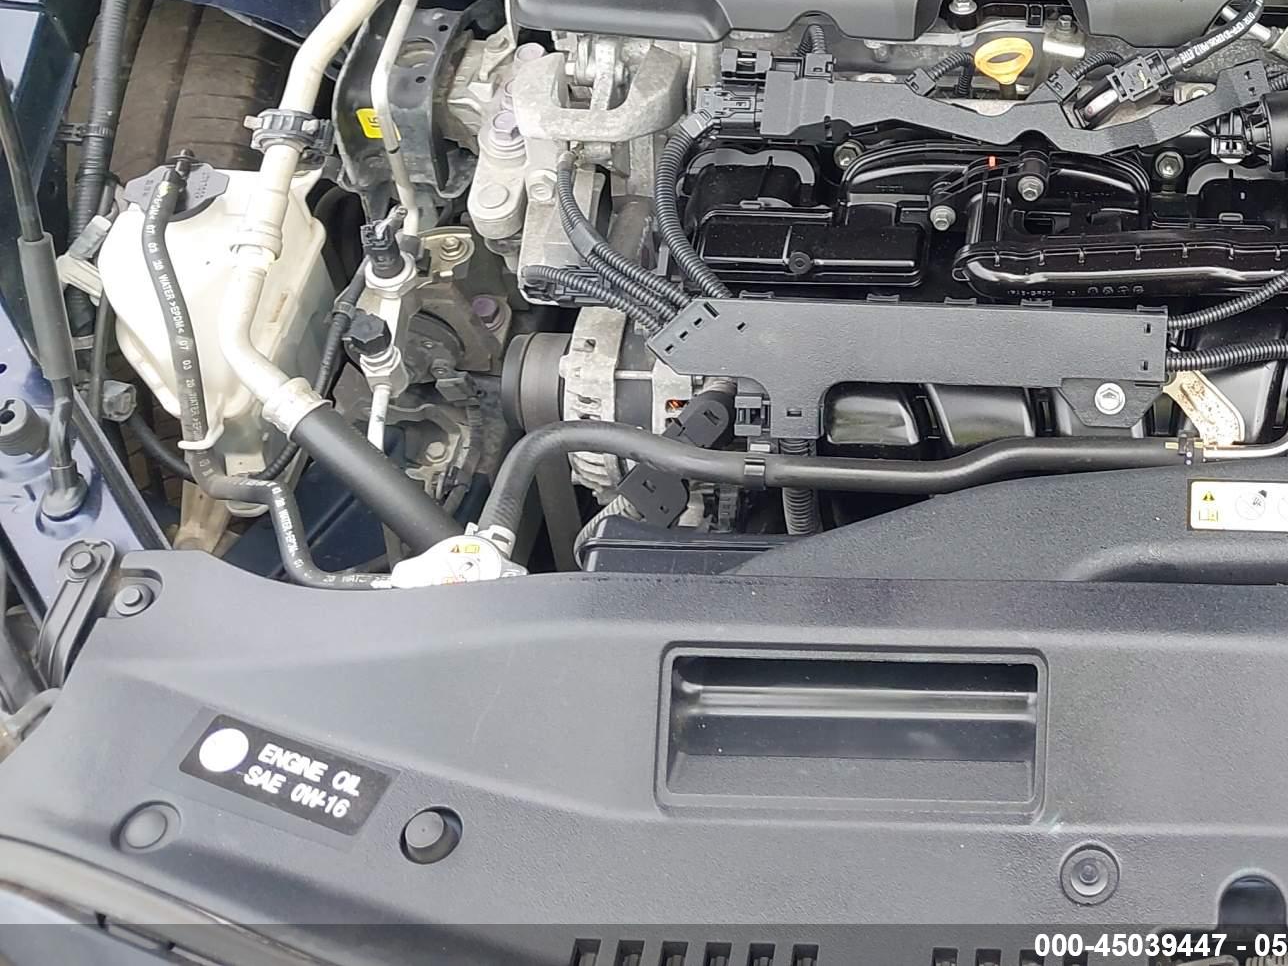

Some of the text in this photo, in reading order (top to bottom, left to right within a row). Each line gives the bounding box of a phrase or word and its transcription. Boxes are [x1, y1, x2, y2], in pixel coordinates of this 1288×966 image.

[158, 273, 175, 301] WATER
[182, 359, 192, 371] 03
[243, 765, 350, 818] SAE 0W-16
[258, 743, 361, 797] ENGINE OIL
